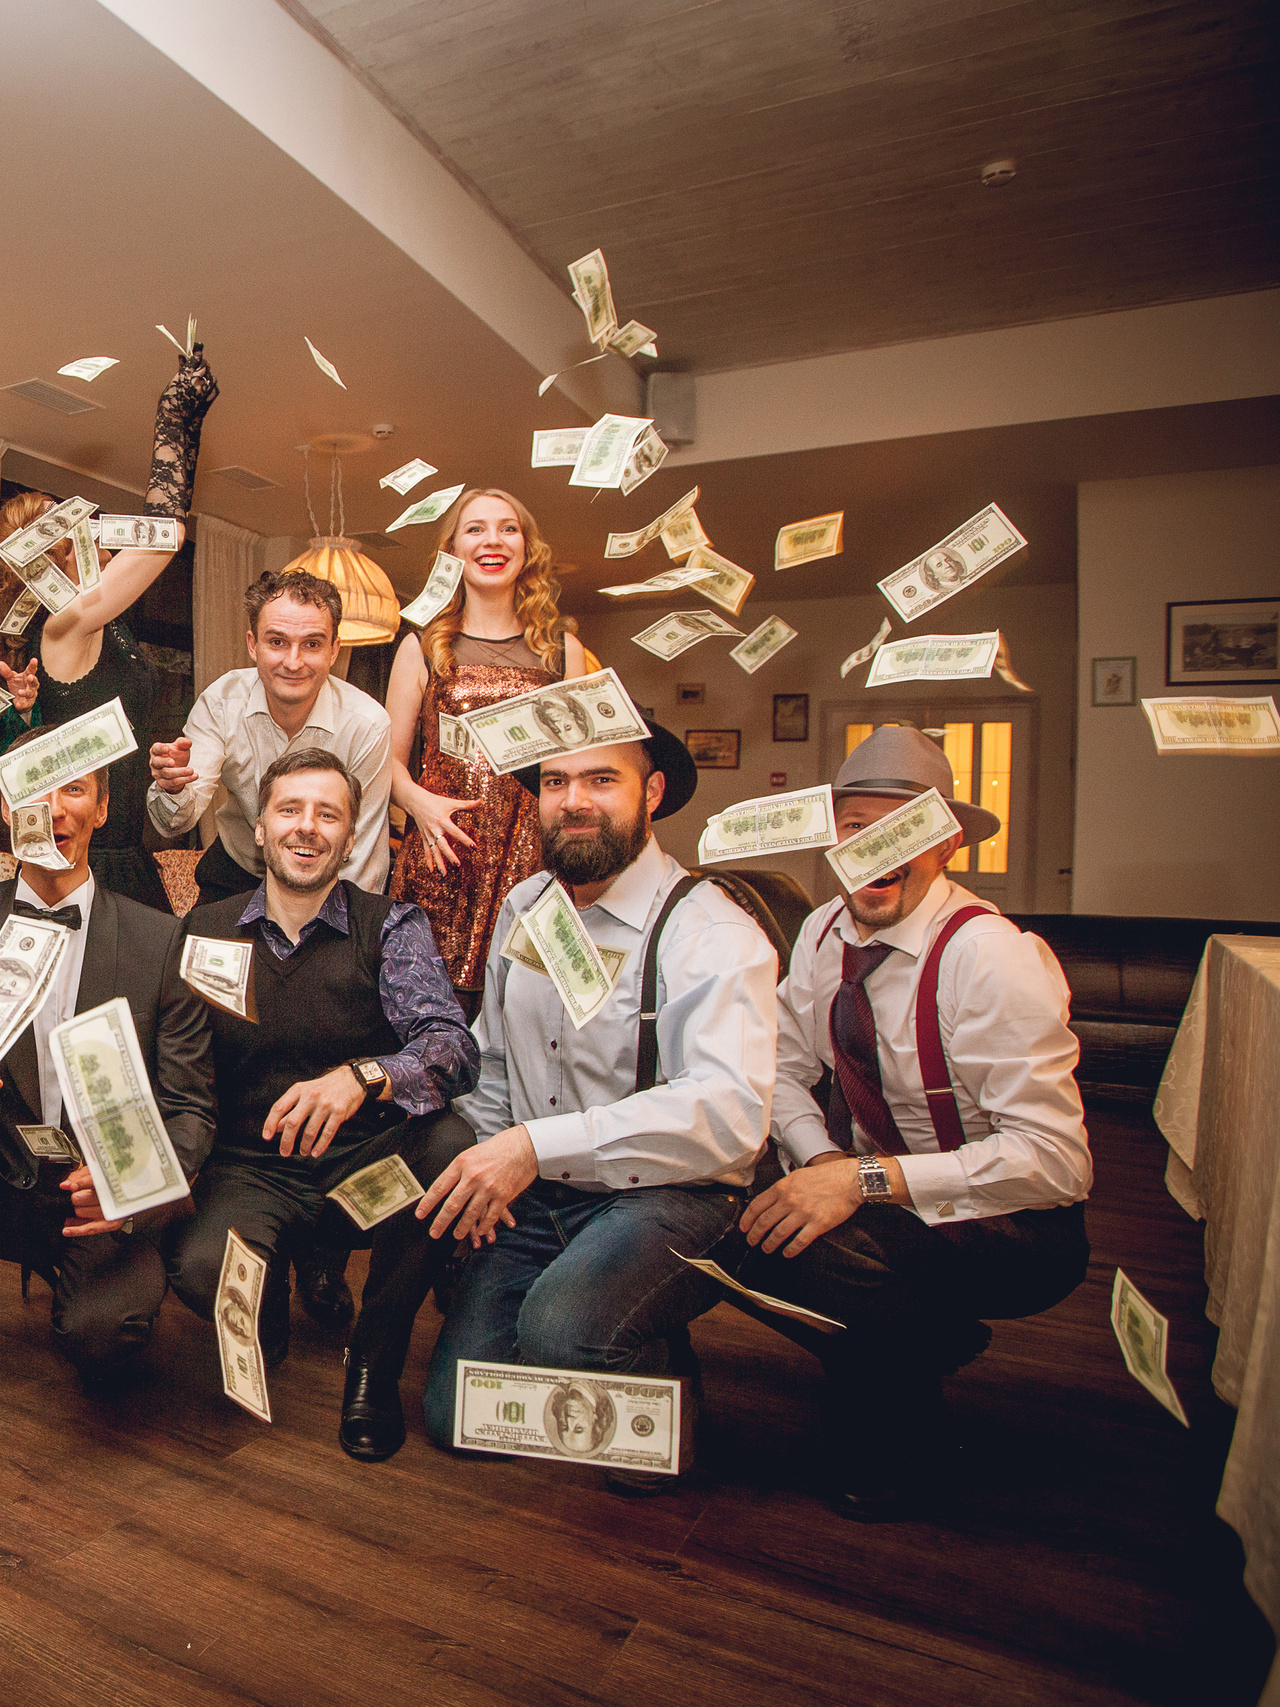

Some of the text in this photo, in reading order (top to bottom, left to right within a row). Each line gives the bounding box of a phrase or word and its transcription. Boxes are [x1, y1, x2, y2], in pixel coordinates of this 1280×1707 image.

[991, 537, 1012, 554] 100
[576, 675, 607, 693] 100
[475, 715, 498, 729] 100
[756, 802, 786, 811] HUNDRE
[753, 841, 775, 849] STATS
[467, 1369, 503, 1377] DOLLARS
[504, 1373, 543, 1381] HUNDRED
[470, 1378, 502, 1389] 100
[623, 1385, 664, 1399] 100
[494, 1400, 526, 1424] 100
